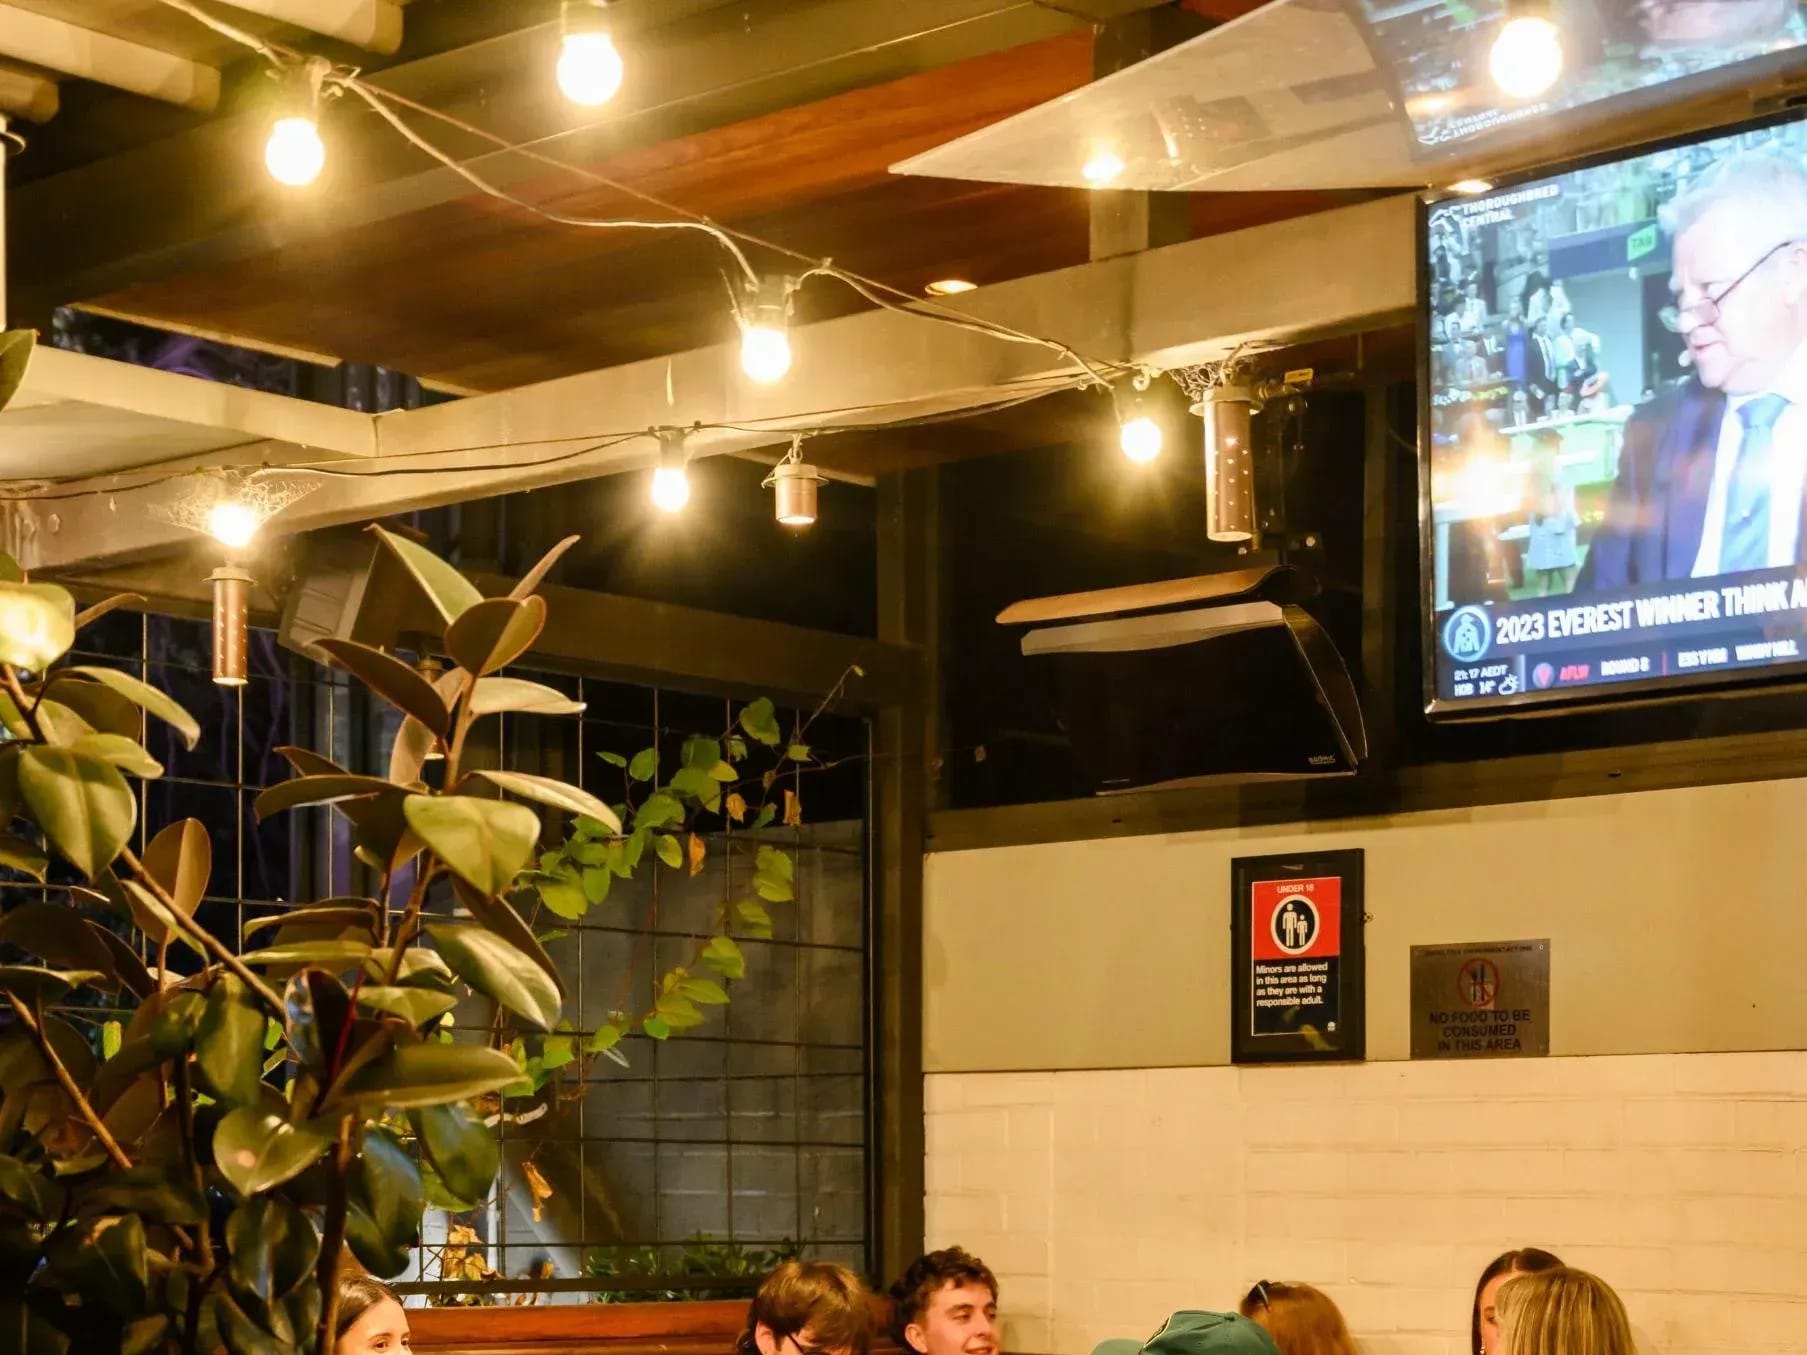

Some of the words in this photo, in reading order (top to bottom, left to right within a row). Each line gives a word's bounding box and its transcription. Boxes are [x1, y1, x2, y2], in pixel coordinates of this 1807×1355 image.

[1462, 184, 1560, 213] THOROUGHBRED
[1462, 208, 1515, 227] CENTRAL
[1496, 616, 1545, 645] 2023
[1548, 602, 1634, 639] EVEREST
[1636, 591, 1720, 628] WINNER
[1721, 580, 1791, 618] THINK
[1790, 577, 1807, 609] A
[1480, 664, 1509, 678] AEDT
[1277, 884, 1304, 895] UNDER
[1305, 883, 1315, 892] 18
[1256, 964, 1283, 974] Minors
[1284, 964, 1297, 973] are
[1297, 961, 1328, 972] allowed
[1256, 975, 1264, 985] in
[1264, 974, 1279, 985] this
[1280, 975, 1297, 984] area
[1298, 974, 1308, 983] as
[1309, 973, 1327, 984] long
[1256, 988, 1266, 997] as
[1266, 986, 1284, 999] they
[1284, 987, 1297, 995] are
[1298, 984, 1316, 994] with
[1256, 996, 1300, 1008] responsible
[1430, 1012, 1449, 1024] NO
[1451, 1010, 1488, 1024] FOOD
[1493, 1010, 1509, 1022] TO
[1512, 1009, 1531, 1021] BE
[1442, 1024, 1517, 1038] CONSUMED
[1437, 1041, 1451, 1052] IN
[1454, 1039, 1483, 1052] THIS
[1486, 1038, 1522, 1050] AREA
